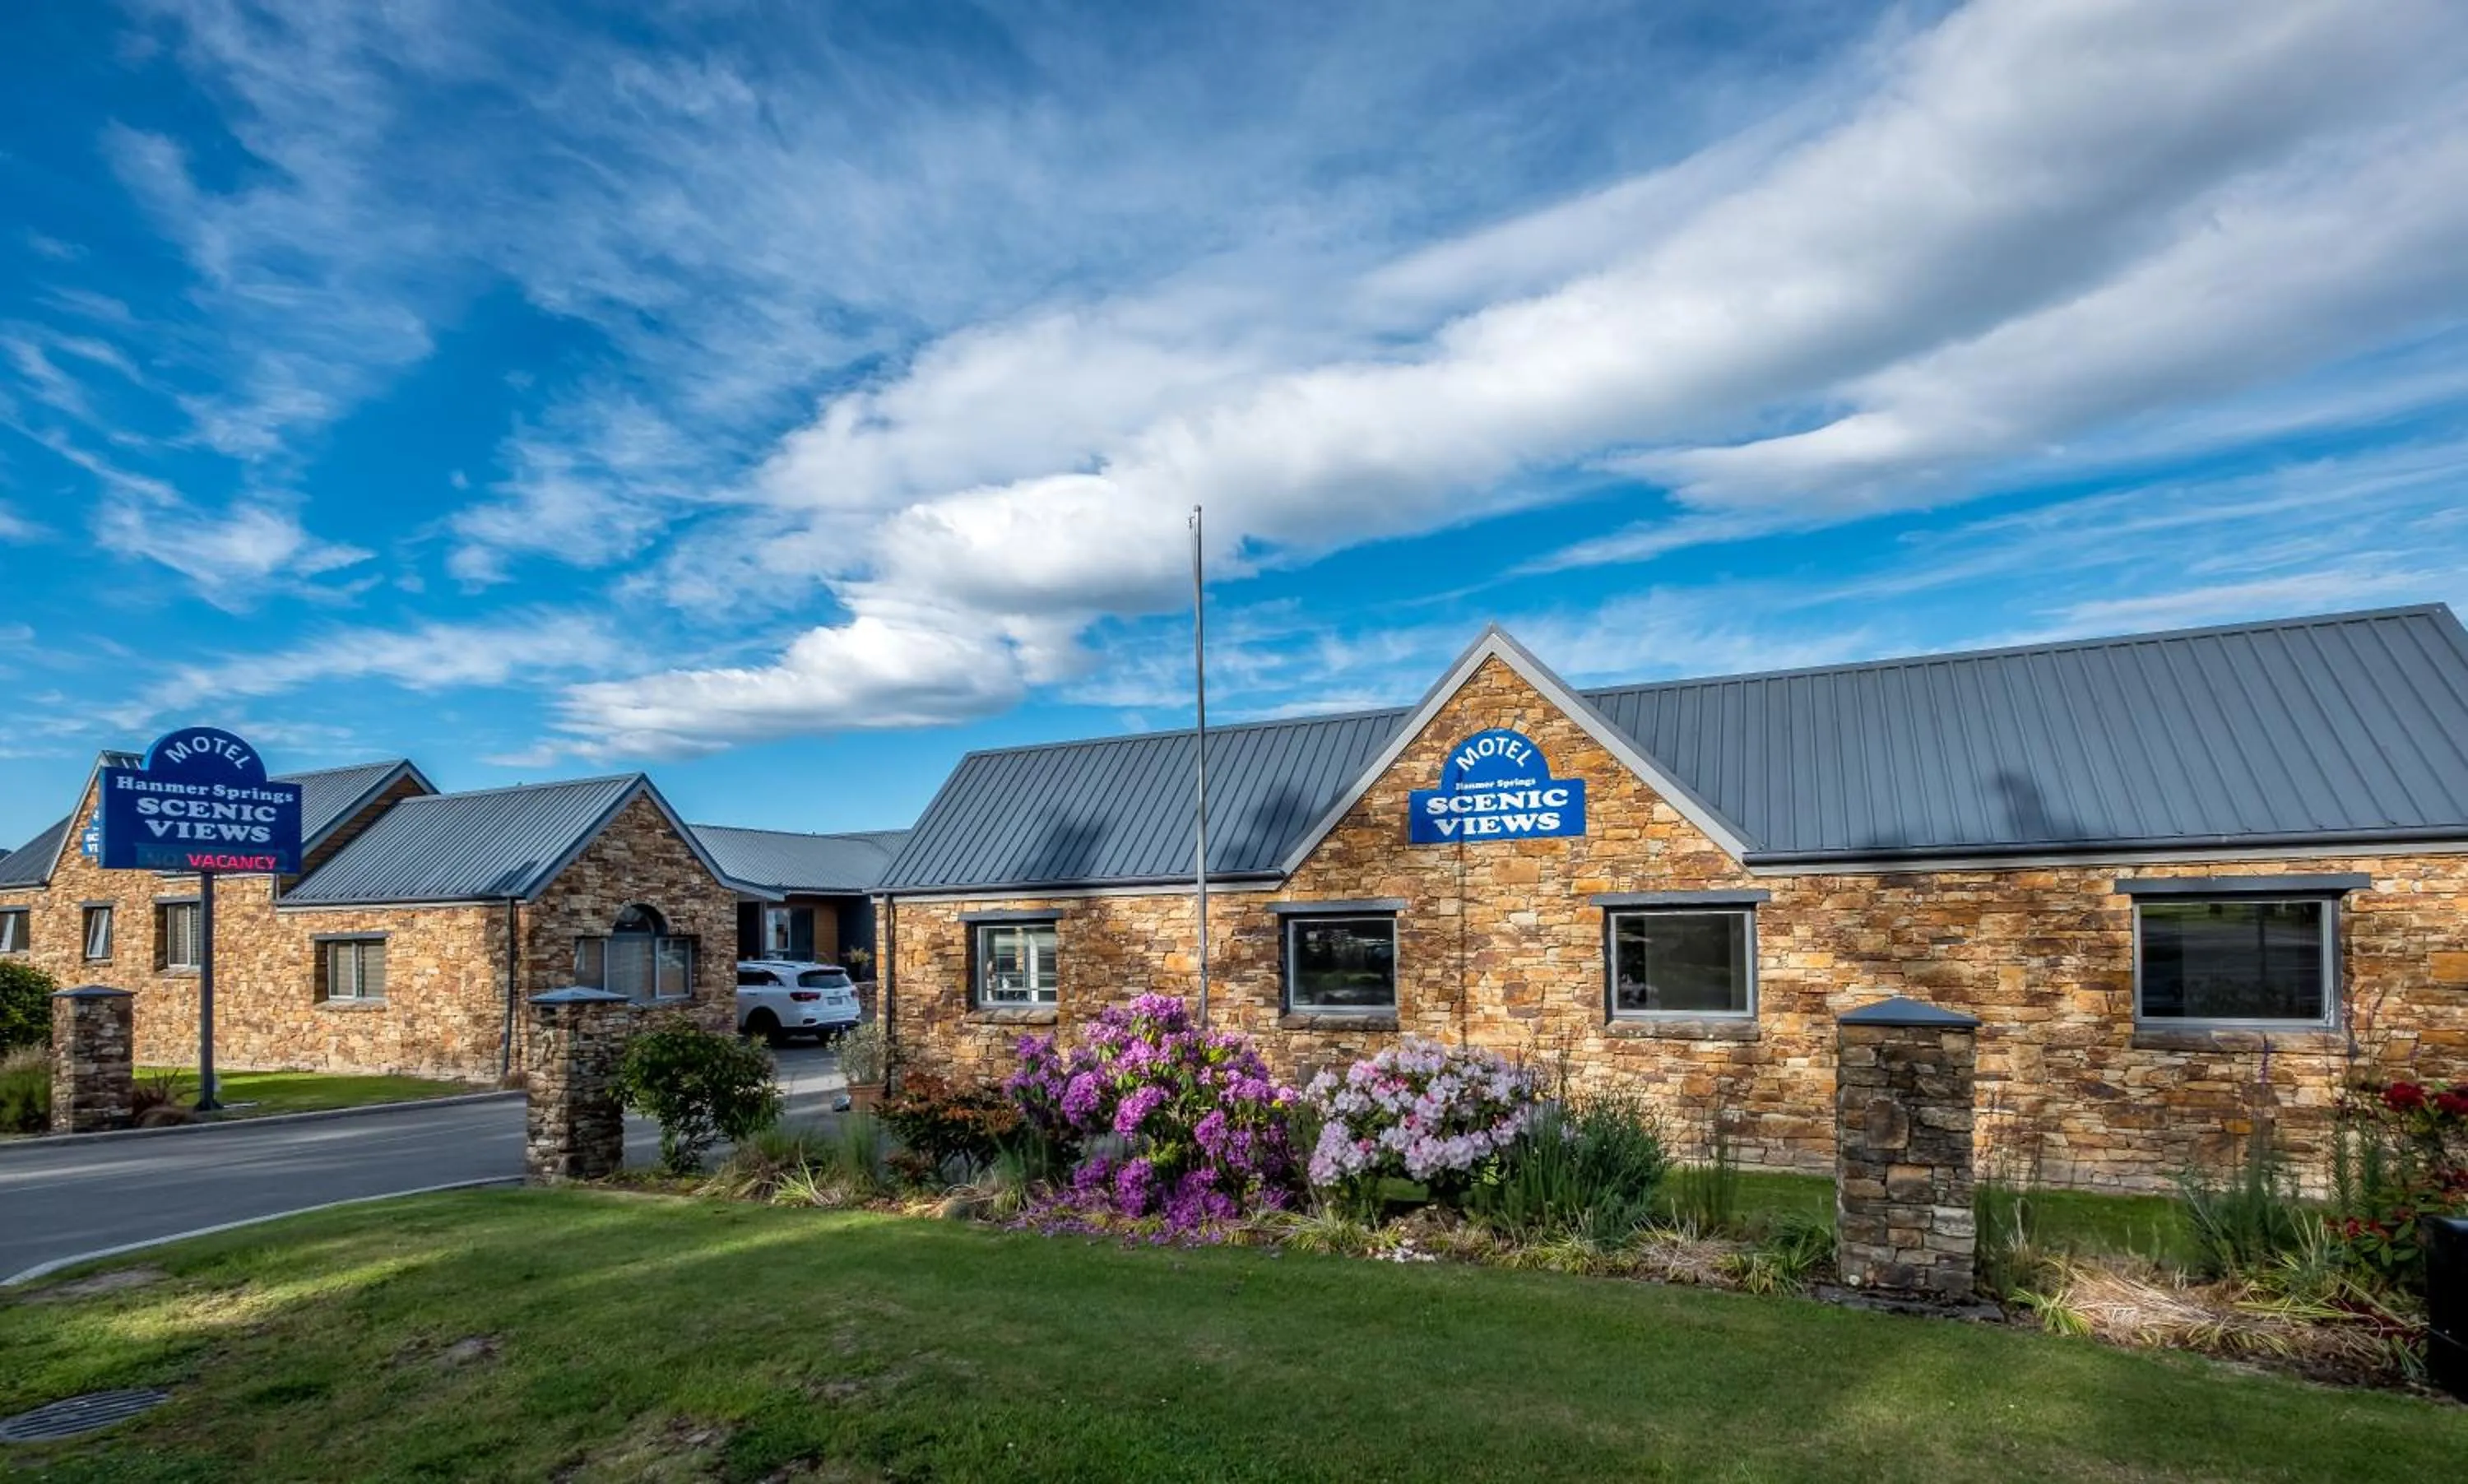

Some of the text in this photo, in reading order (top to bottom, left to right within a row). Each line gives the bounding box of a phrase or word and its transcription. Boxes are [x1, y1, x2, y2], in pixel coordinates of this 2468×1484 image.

[165, 736, 250, 769] MOTEL
[1455, 736, 1532, 771] MOTEL
[116, 776, 295, 805] Hanmer Springs
[1455, 777, 1536, 791] Hanmer Springs
[136, 797, 277, 823] SCENIC
[1427, 789, 1568, 814] SCENIC
[145, 819, 271, 843] VIEWS
[1433, 812, 1561, 837] VIEWS
[187, 854, 276, 870] VACANCY
